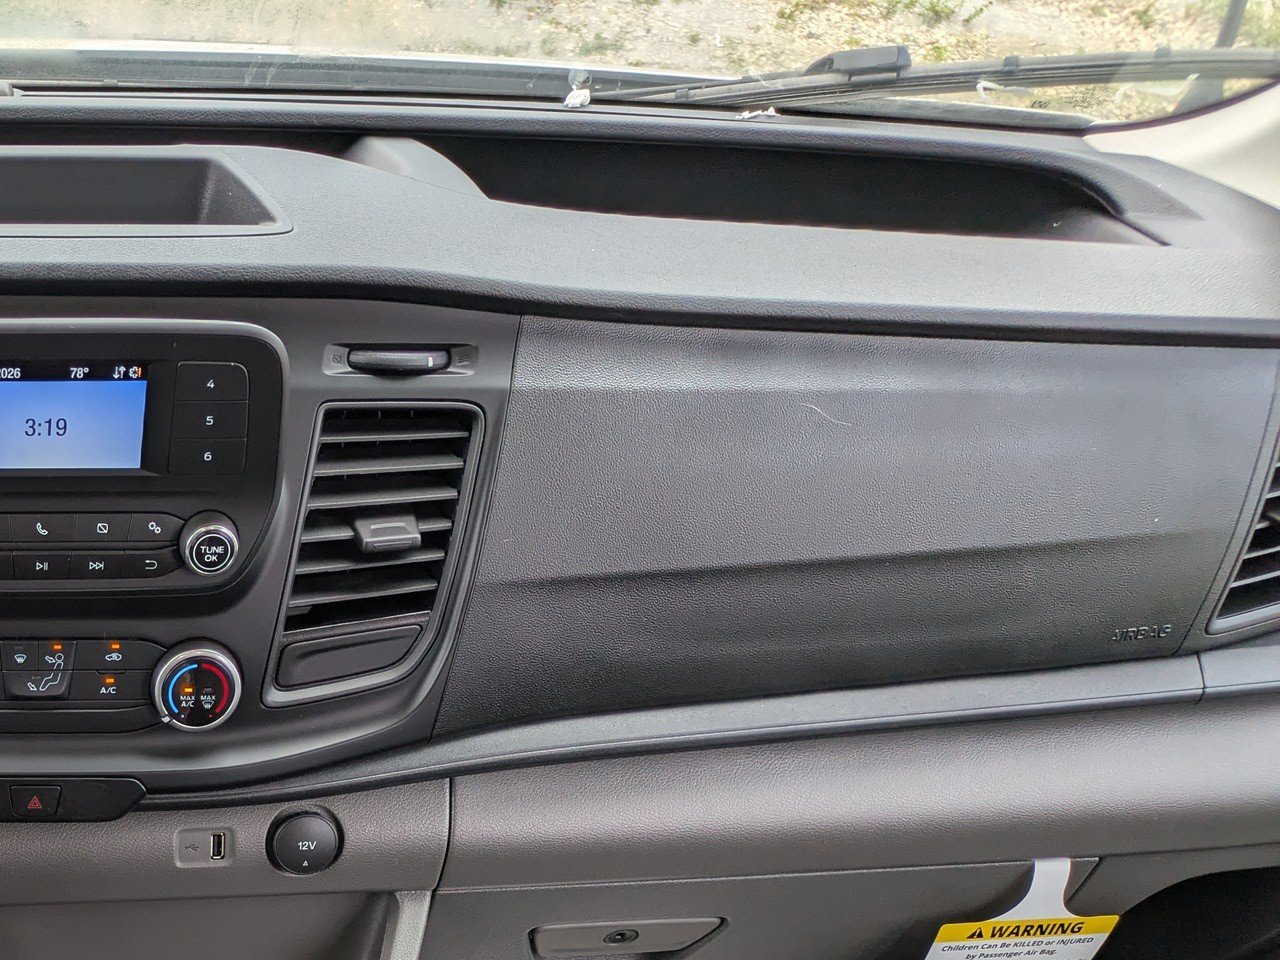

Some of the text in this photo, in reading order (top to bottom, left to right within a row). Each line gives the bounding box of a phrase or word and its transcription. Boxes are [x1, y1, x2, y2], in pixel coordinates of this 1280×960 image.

[70, 367, 89, 379] 78°
[206, 379, 215, 389] 4
[206, 416, 214, 425] 5
[24, 418, 68, 437] 3:19
[204, 452, 212, 461] 6
[200, 546, 225, 554] TUNE
[204, 554, 218, 563] OK
[298, 841, 317, 850] 12V
[989, 921, 1085, 939] WARNING
[941, 944, 979, 952] Children
[999, 941, 1012, 949] Be
[1012, 940, 1044, 948] KILLED
[1056, 937, 1094, 945] INJURED
[978, 950, 1024, 959] Passenger
